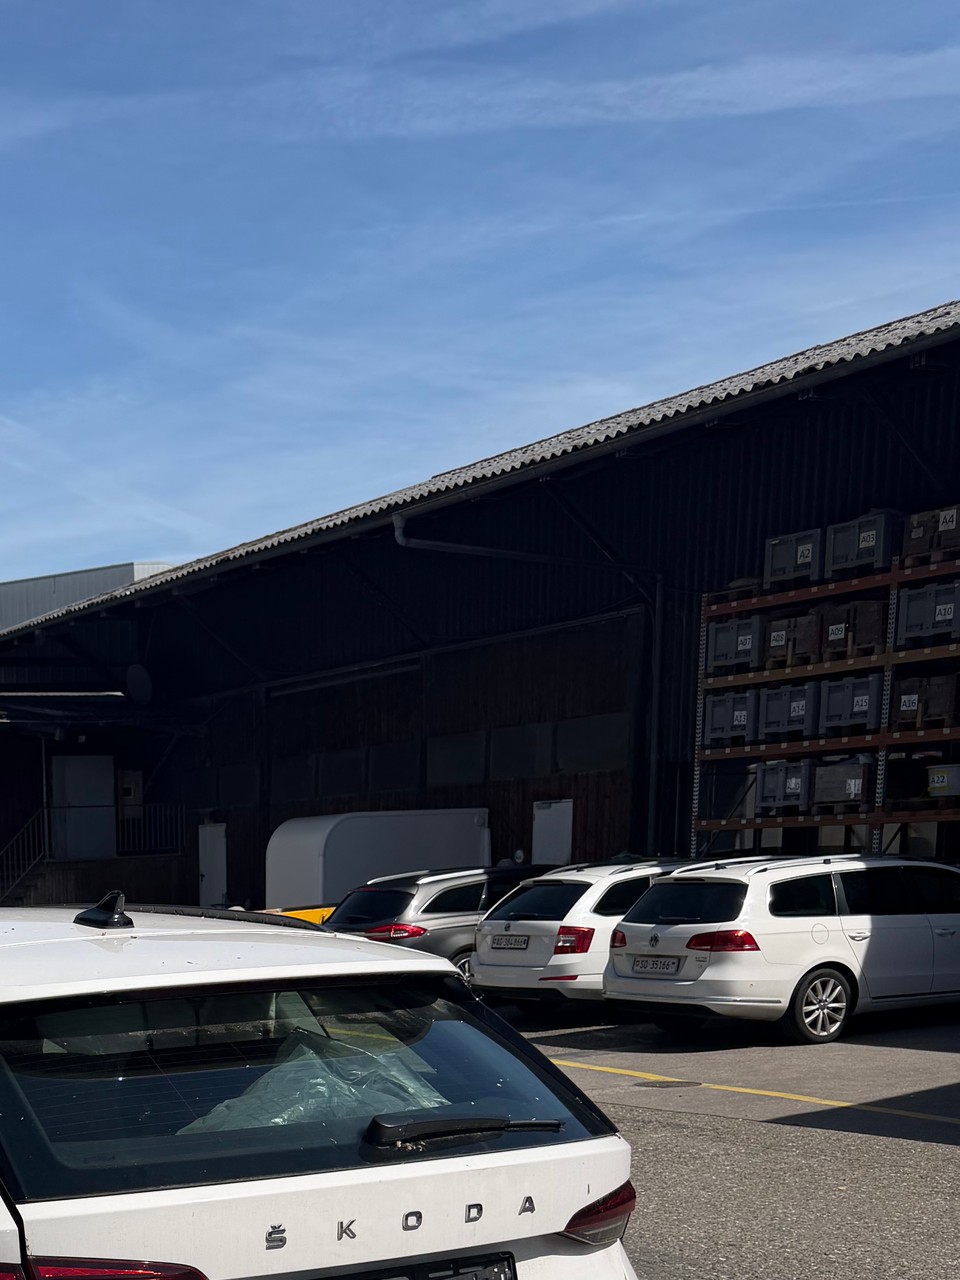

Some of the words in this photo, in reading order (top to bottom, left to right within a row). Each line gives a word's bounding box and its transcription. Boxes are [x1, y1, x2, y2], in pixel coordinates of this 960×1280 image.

[941, 513, 954, 526] A4
[860, 533, 875, 544] A03
[799, 548, 811, 560] A2
[936, 606, 952, 618] A10
[830, 626, 843, 637] A09
[738, 637, 751, 647] A07
[771, 633, 784, 643] A08
[854, 698, 868, 708] A15
[901, 698, 917, 708] A16
[791, 704, 805, 714] A14
[734, 713, 746, 723] A13
[930, 775, 946, 784] A22
[265, 1195, 536, 1251] ŠKODA
